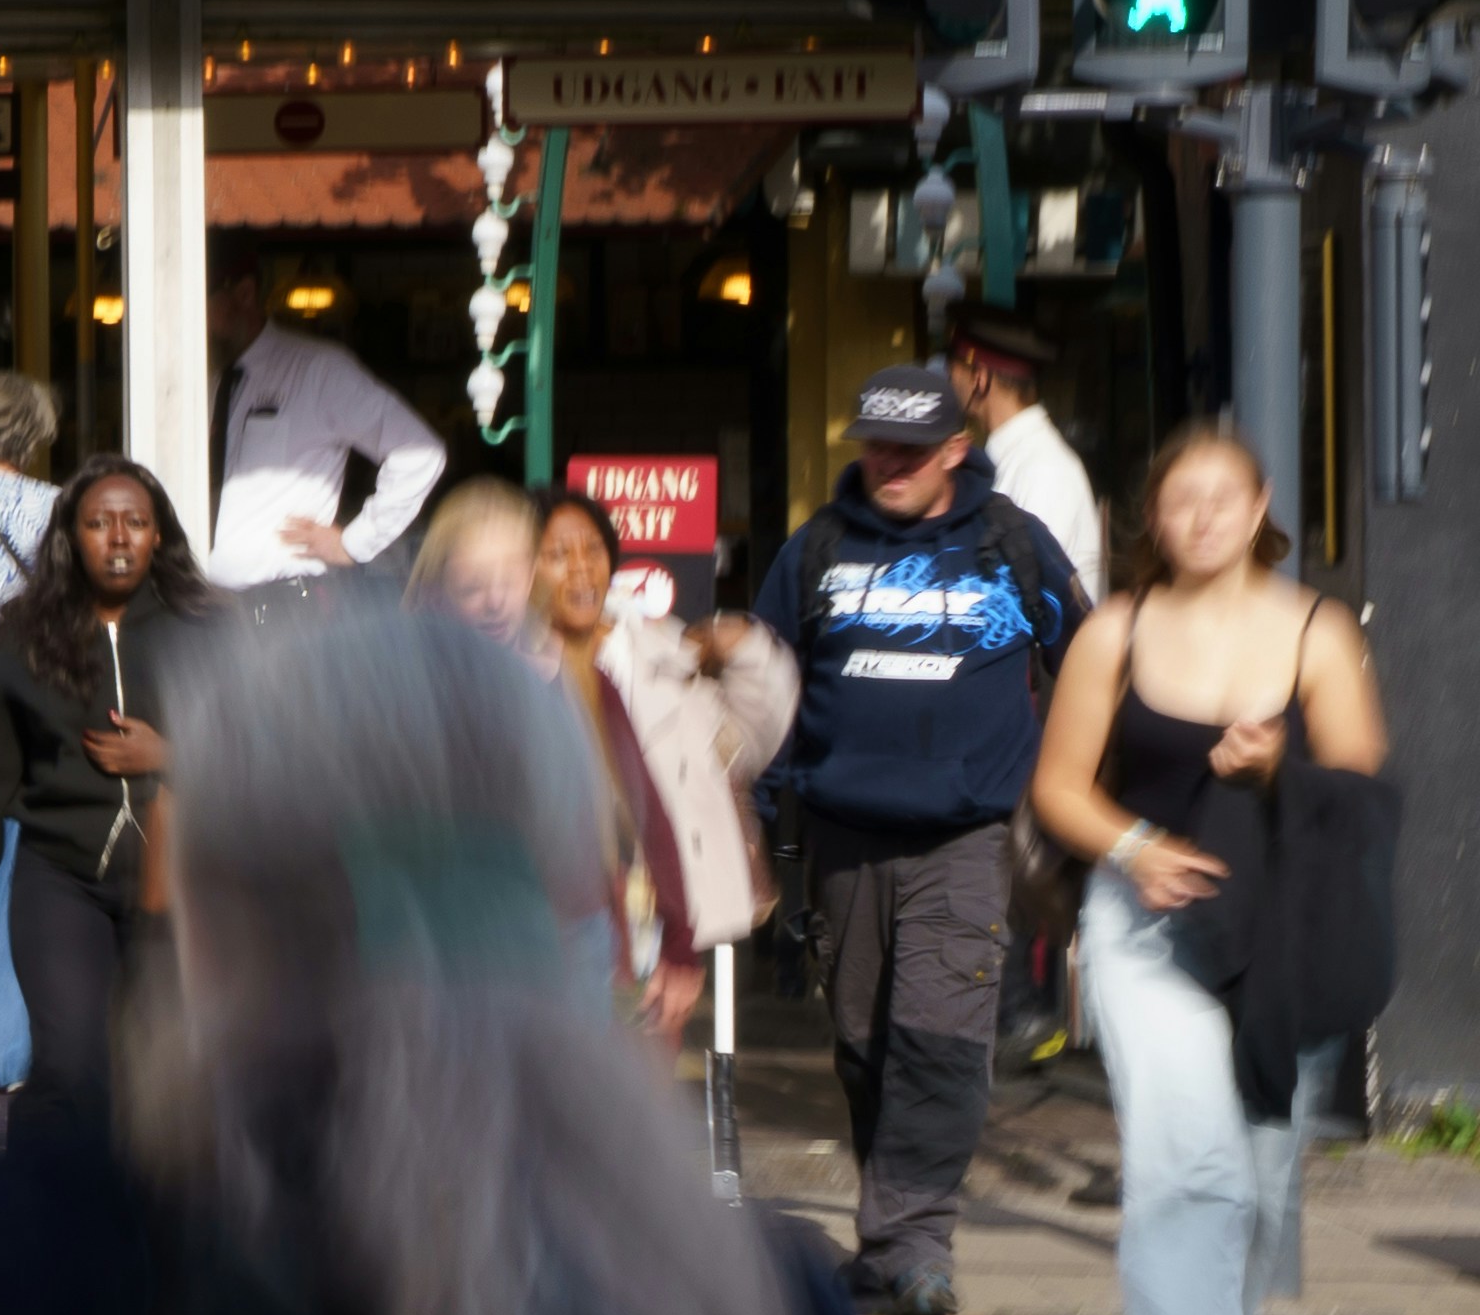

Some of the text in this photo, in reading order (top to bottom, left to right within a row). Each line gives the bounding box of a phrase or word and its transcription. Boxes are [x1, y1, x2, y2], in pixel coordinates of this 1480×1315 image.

[553, 63, 876, 106] UDGANG EXIT
[586, 465, 699, 502] UDGANG
